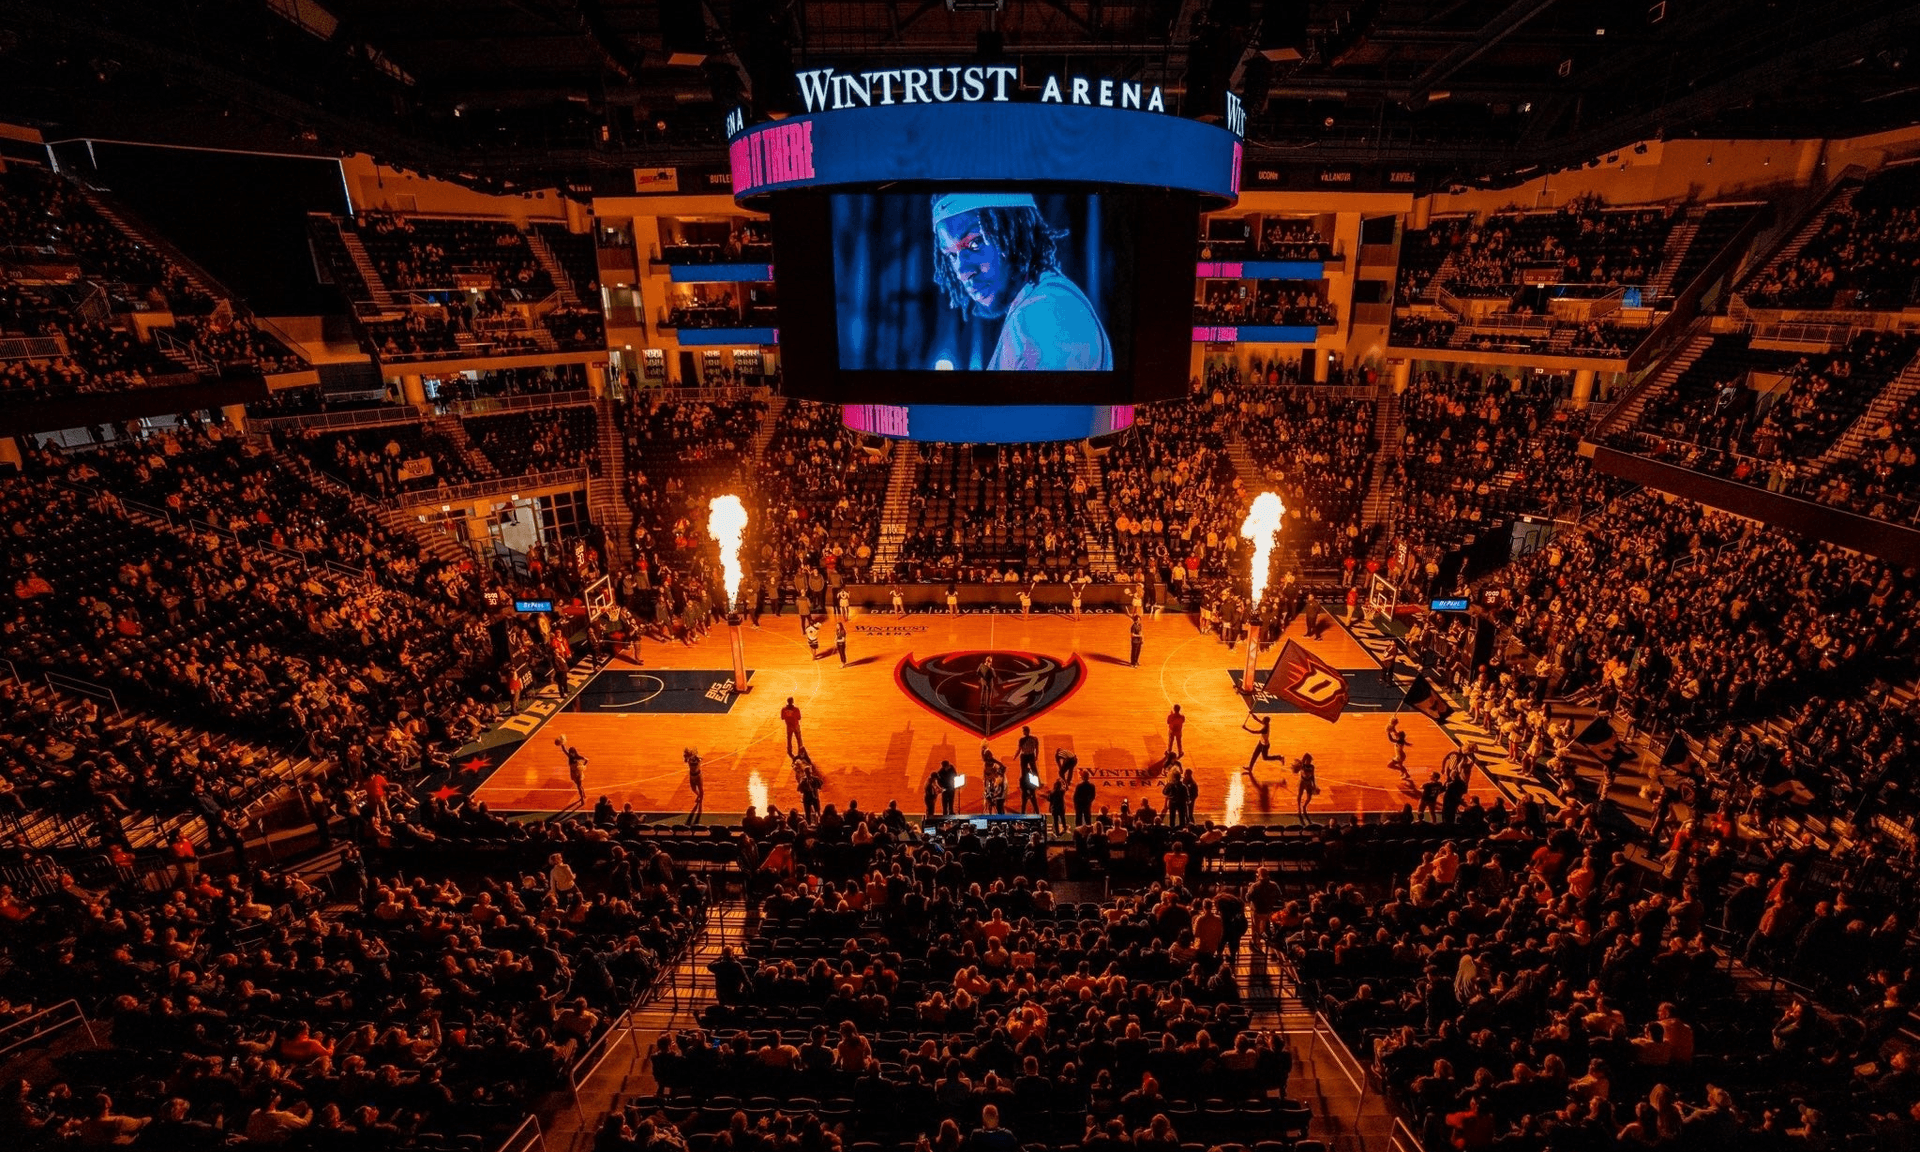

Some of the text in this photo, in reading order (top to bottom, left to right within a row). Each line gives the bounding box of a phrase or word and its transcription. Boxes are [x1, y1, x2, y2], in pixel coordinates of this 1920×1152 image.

[796, 68, 1164, 113] WINTRUST ARENA
[762, 120, 815, 185] THERE
[709, 174, 732, 184] BUTLE
[704, 682, 723, 699] BIG
[714, 678, 735, 702] EAST
[1103, 780, 1167, 788] ARENA
